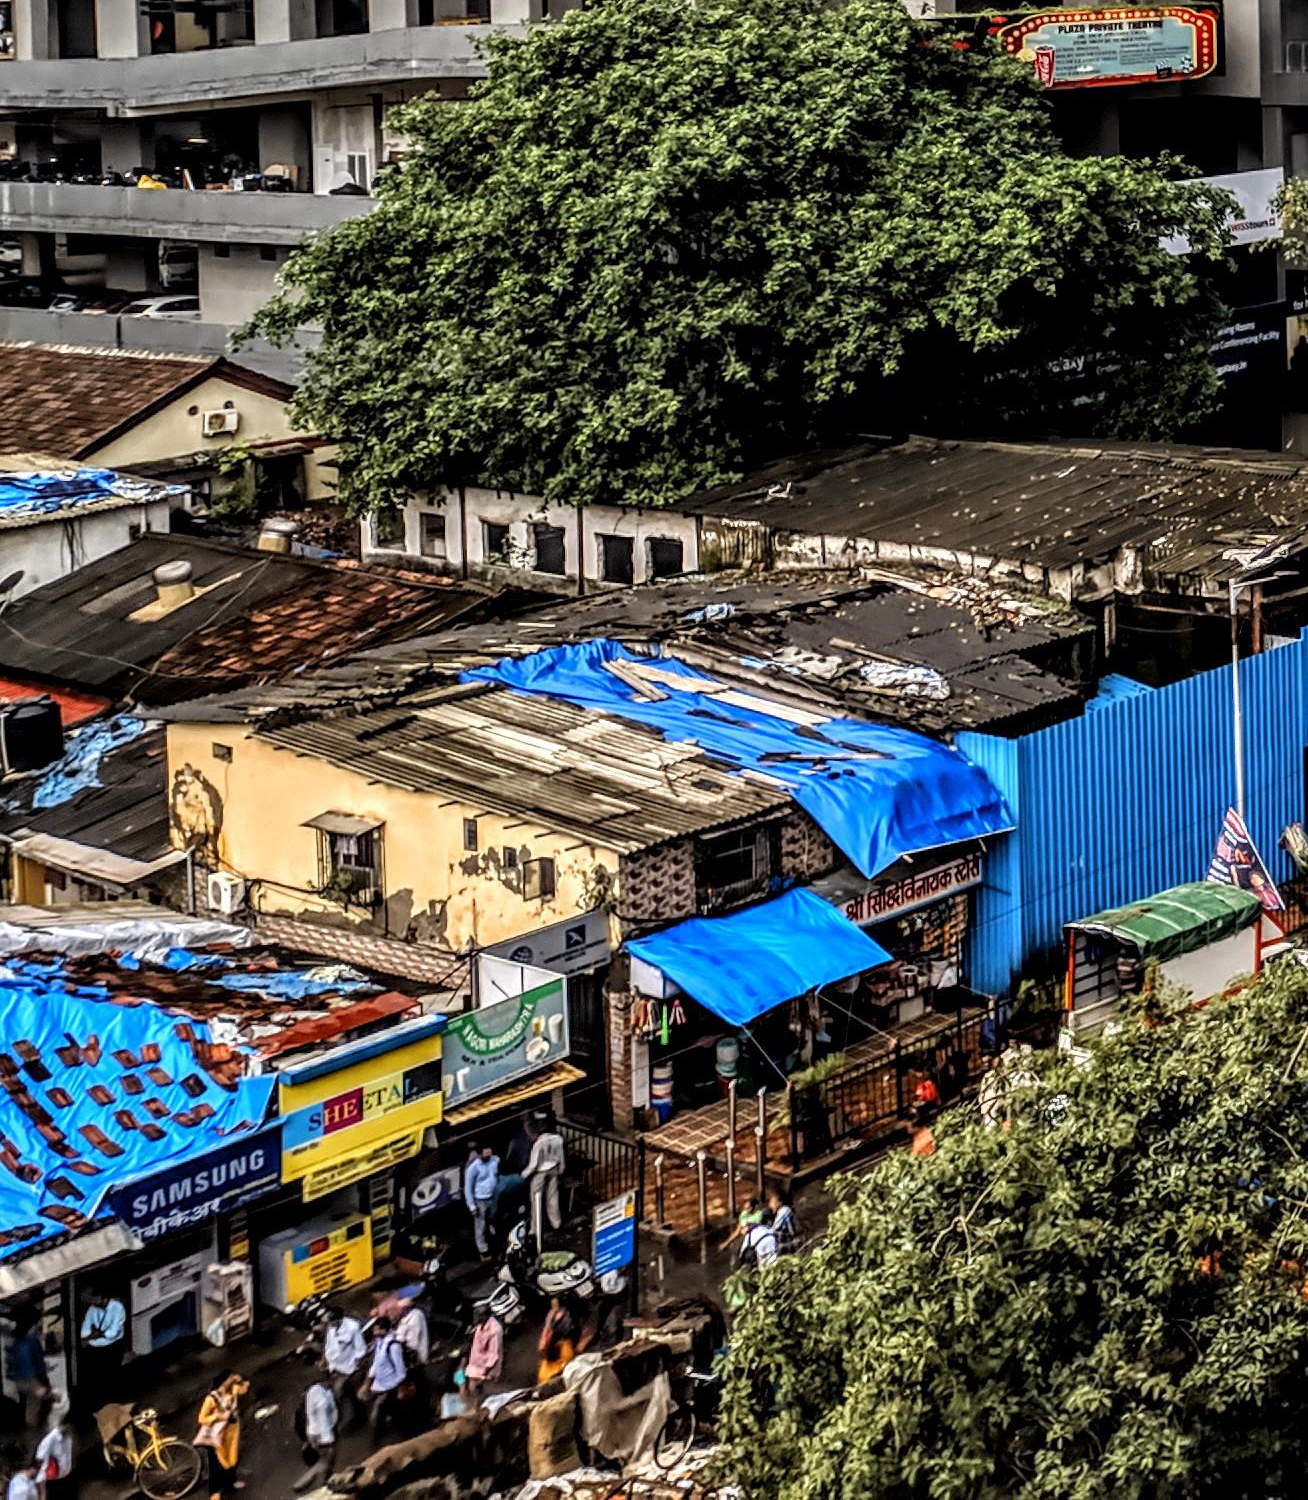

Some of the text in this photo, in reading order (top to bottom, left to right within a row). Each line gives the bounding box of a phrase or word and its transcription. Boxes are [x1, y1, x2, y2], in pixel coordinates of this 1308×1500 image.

[1088, 21, 1123, 32] PRIVATE
[308, 1078, 418, 1132] SHEETAL
[132, 1149, 265, 1219] SAMSUNG
